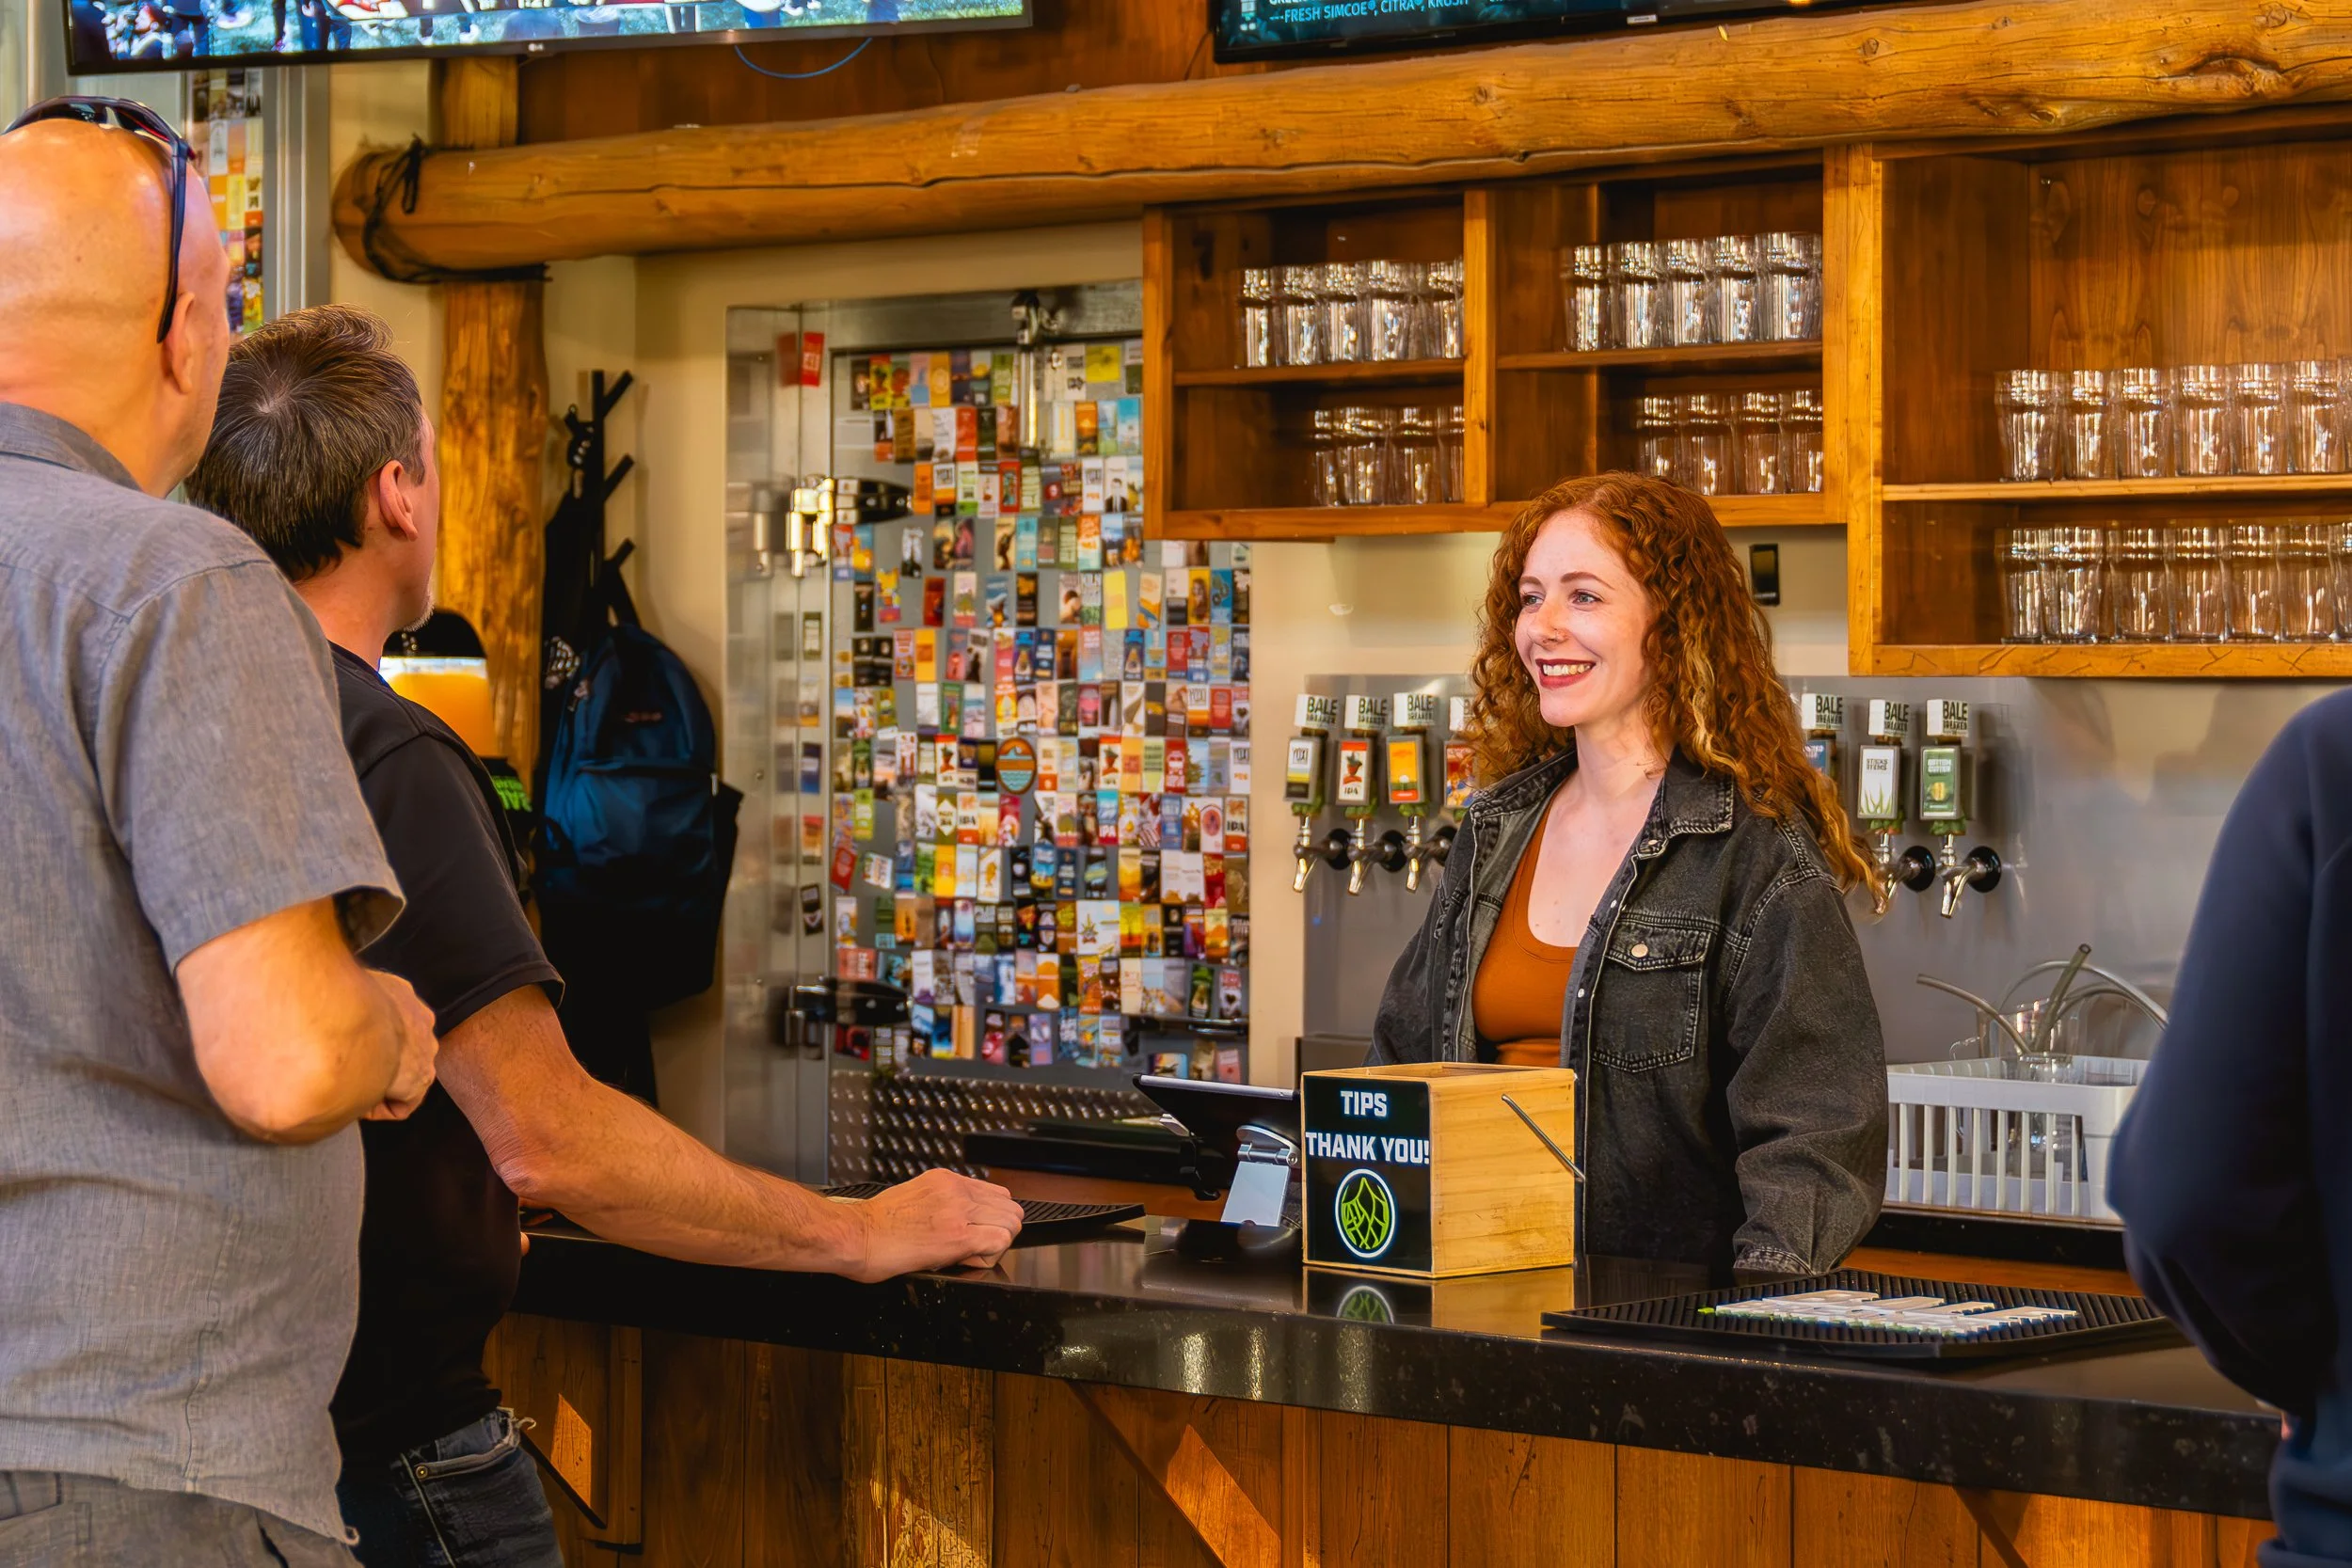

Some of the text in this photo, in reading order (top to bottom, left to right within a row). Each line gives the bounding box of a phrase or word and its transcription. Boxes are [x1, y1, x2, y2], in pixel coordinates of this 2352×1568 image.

[1308, 697, 1338, 715] BALE
[1359, 698, 1388, 716] BALE
[1407, 695, 1433, 711] BALE
[1816, 695, 1843, 715] BALE
[1884, 702, 1910, 722] BALE
[1943, 701, 1968, 721] BALE
[1099, 825, 1118, 838] IPA
[1227, 820, 1246, 832] IPA
[1340, 1090, 1388, 1117] TIPS
[1306, 1132, 1430, 1165] THANK YOU!
